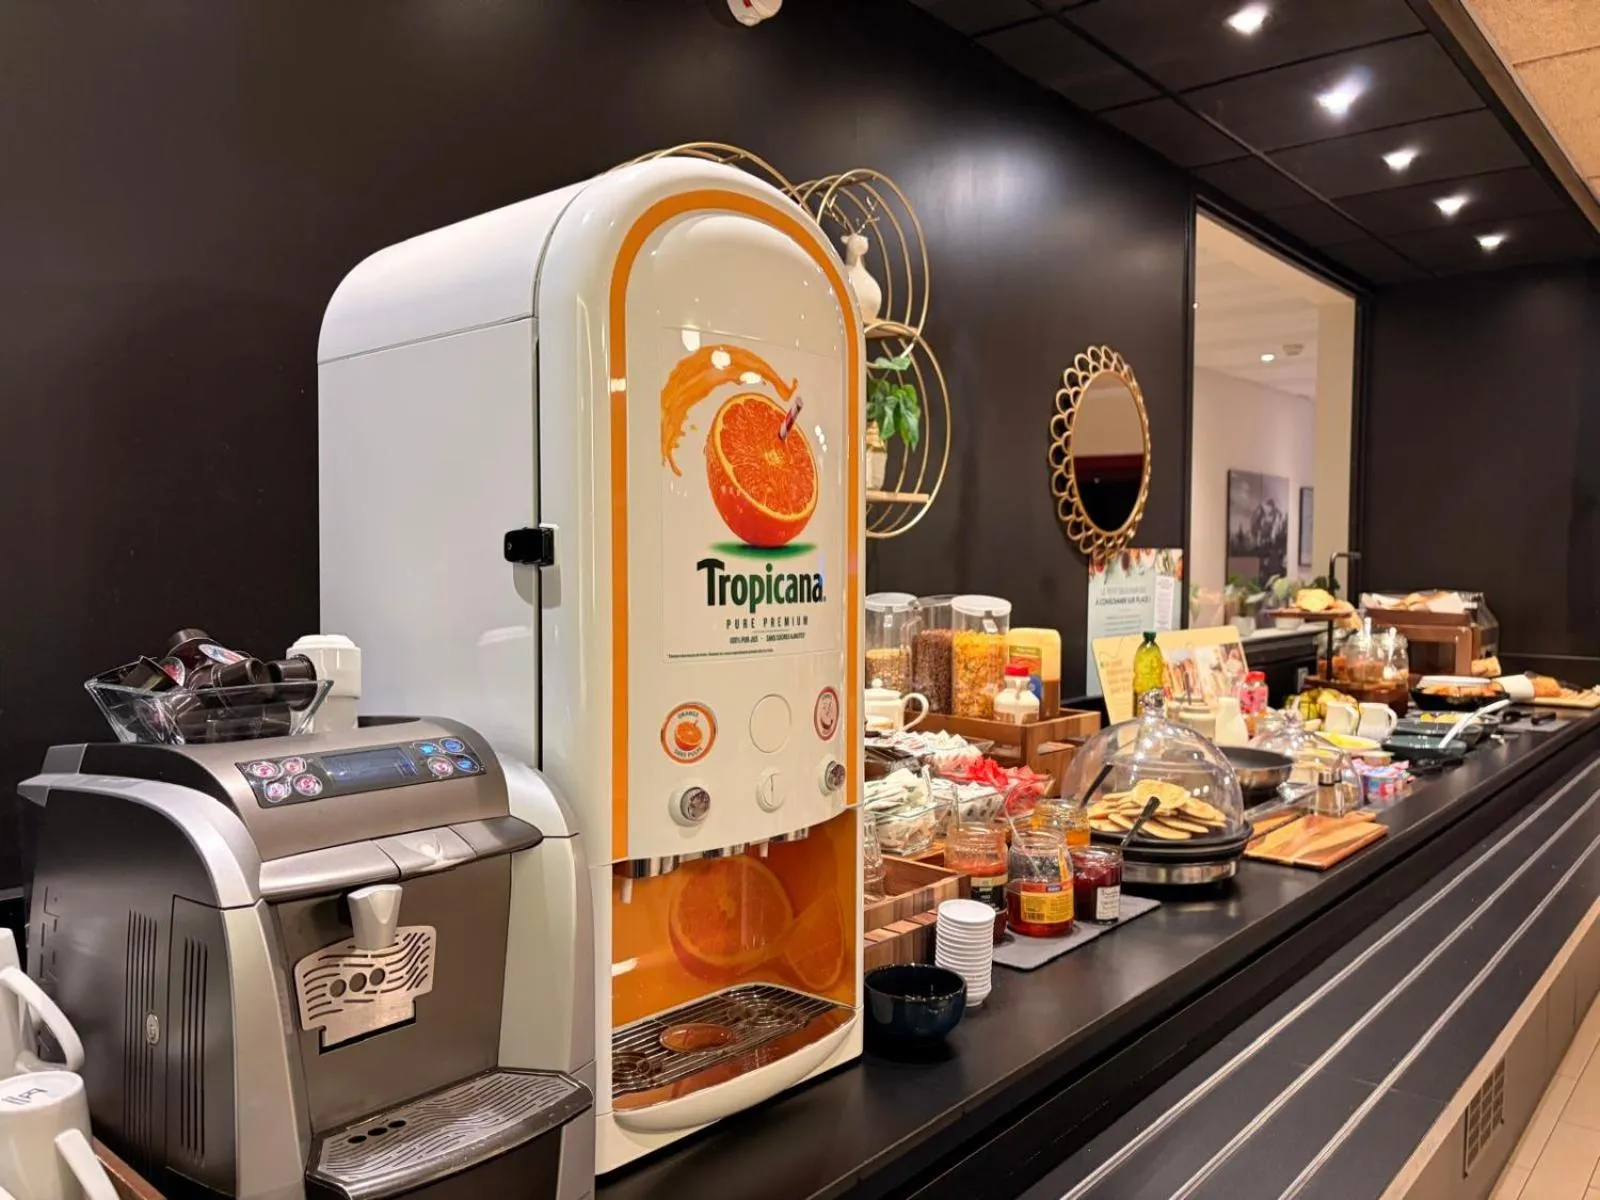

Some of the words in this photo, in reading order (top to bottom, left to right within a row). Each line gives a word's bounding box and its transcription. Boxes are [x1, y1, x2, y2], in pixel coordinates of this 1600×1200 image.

[697, 558, 824, 613] Tropicana
[726, 617, 755, 629] PURE
[763, 615, 808, 628] PREMIUM
